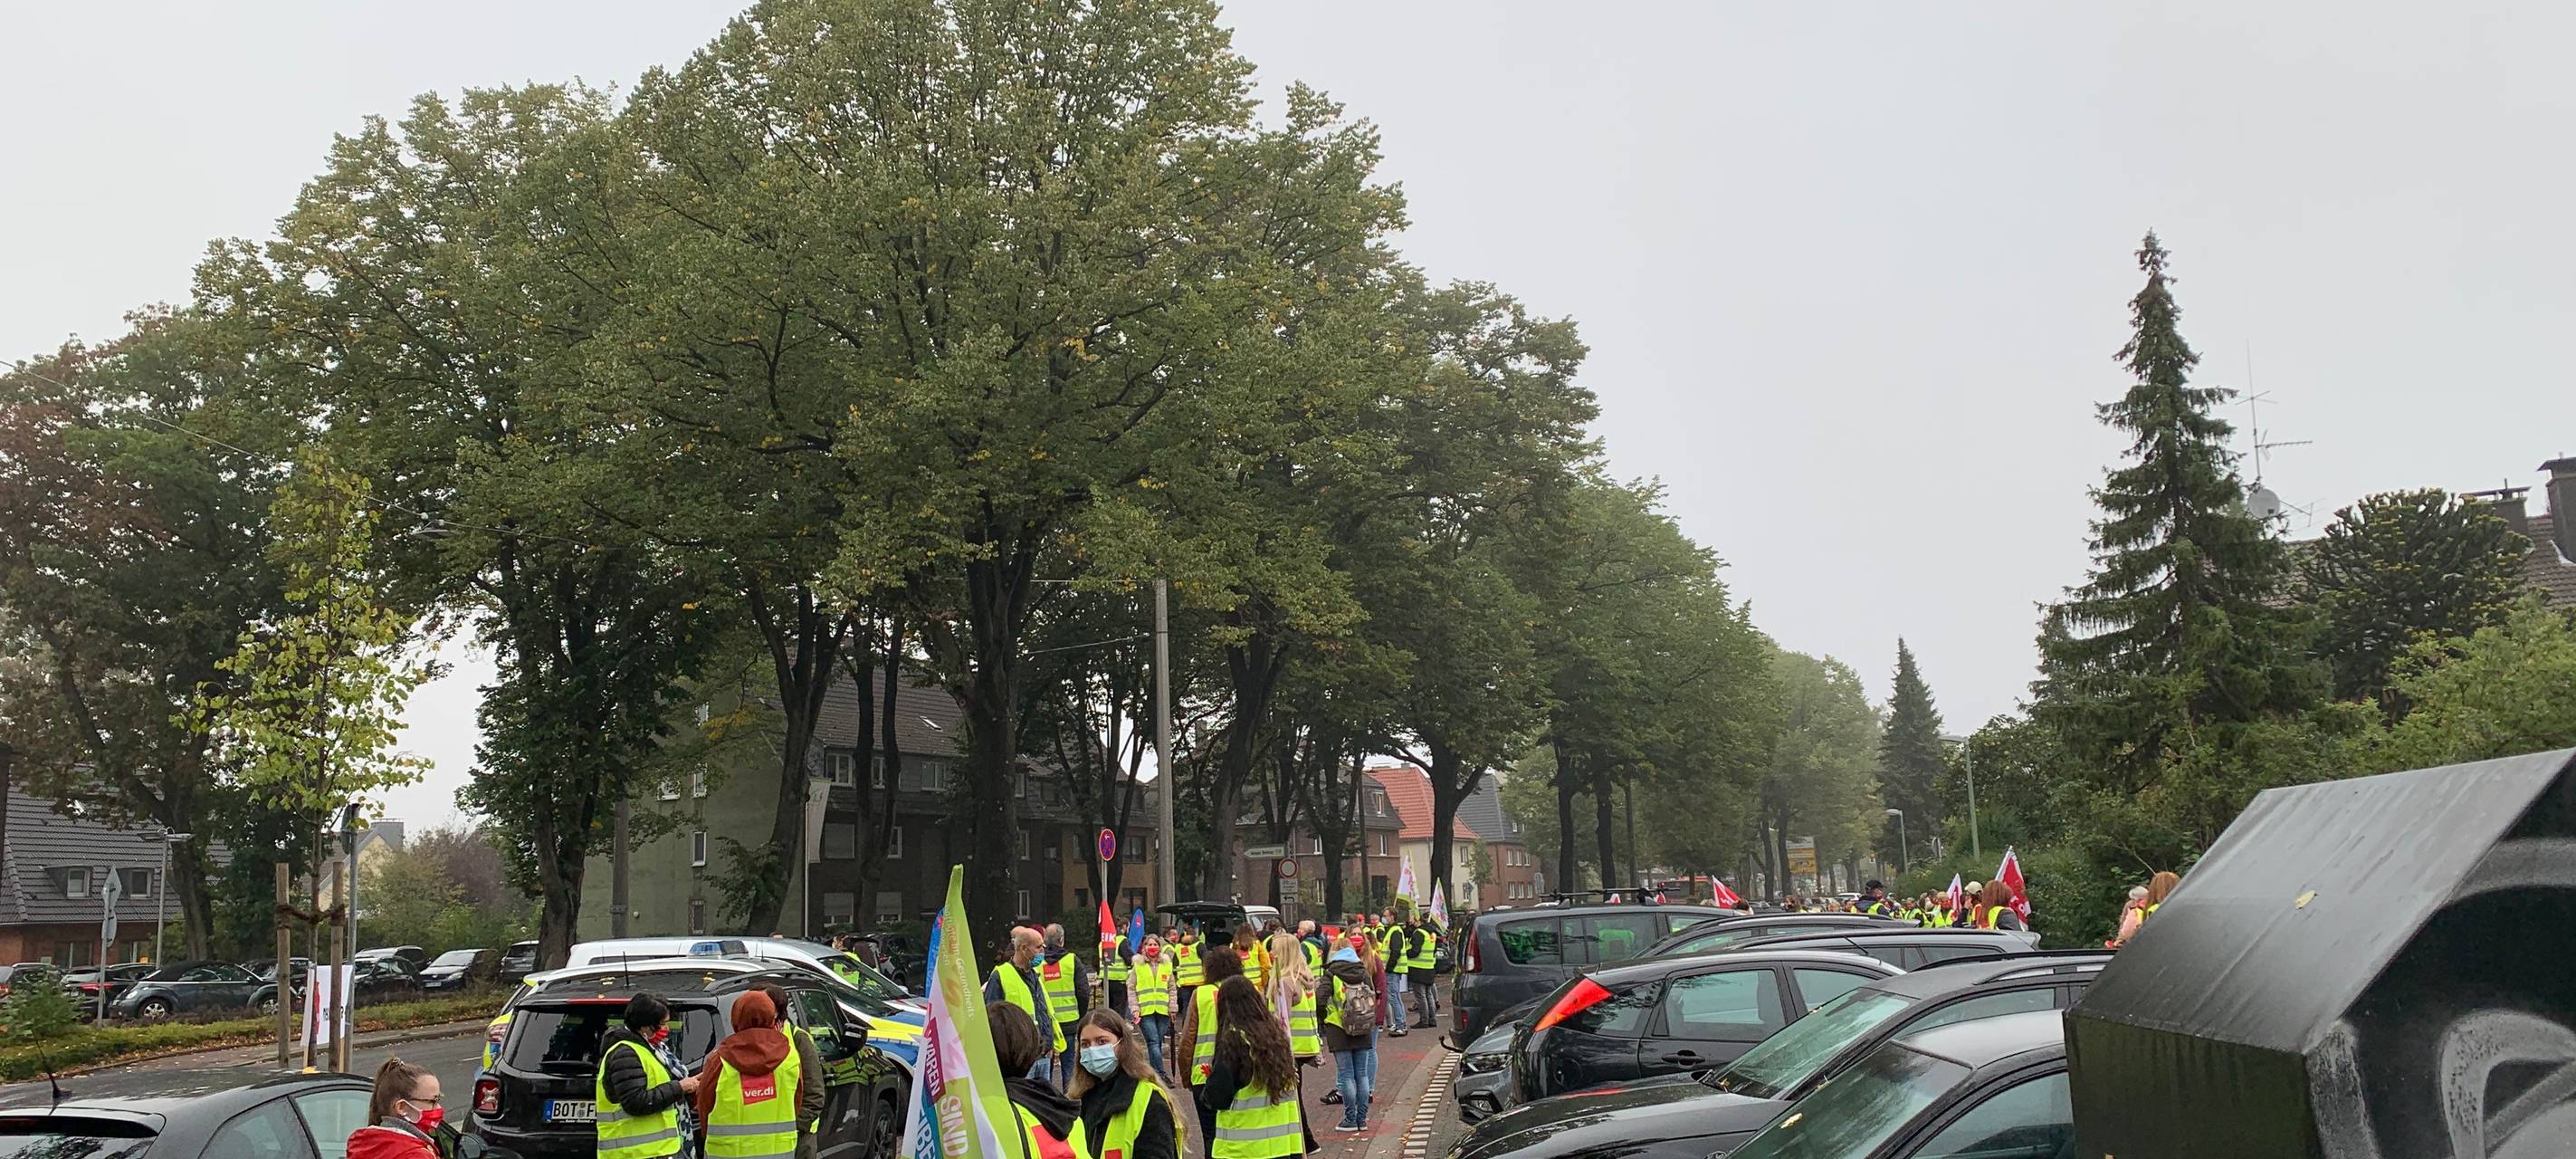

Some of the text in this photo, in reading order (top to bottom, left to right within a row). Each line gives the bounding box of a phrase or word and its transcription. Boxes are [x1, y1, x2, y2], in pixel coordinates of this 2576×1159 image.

[744, 1086, 774, 1097] ver.di
[553, 1102, 597, 1117] BOT F
[940, 1096, 969, 1157] SIND
